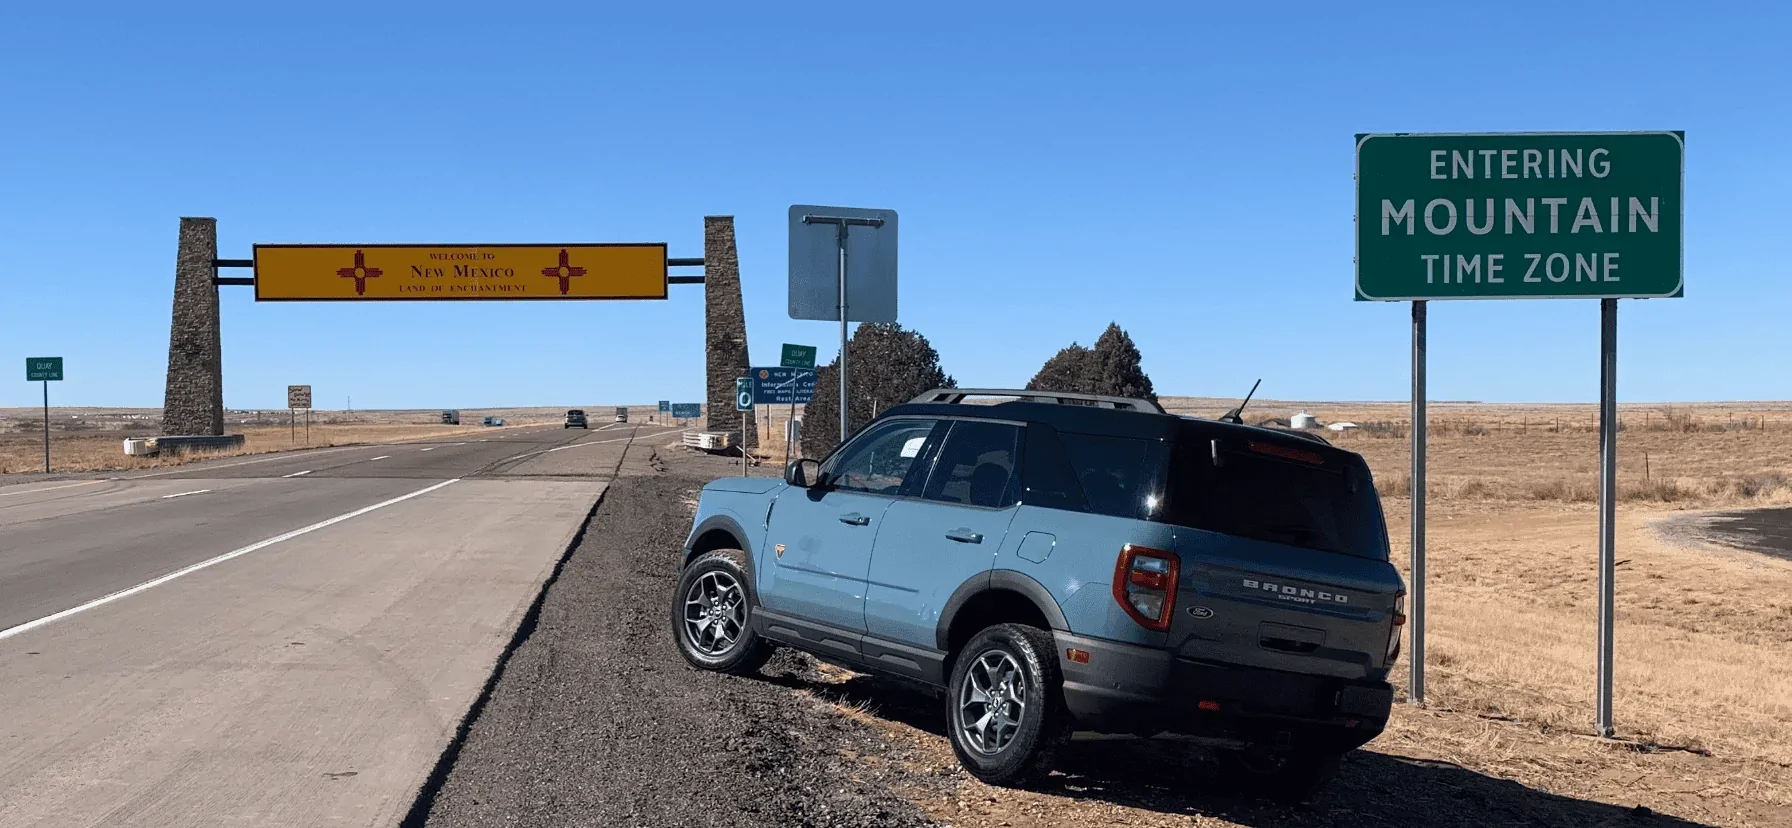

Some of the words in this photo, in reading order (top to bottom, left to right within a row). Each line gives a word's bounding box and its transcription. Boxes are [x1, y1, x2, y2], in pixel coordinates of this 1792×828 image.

[1430, 148, 1611, 180] ENTERING
[1381, 196, 1660, 235] MOUNTAIN
[429, 252, 478, 260] WELCOME
[483, 252, 495, 260] TO
[1421, 254, 1505, 284] TIME
[1523, 252, 1621, 283] ZONE
[399, 284, 426, 293] LAND
[431, 284, 444, 293] OF
[450, 283, 528, 293] ENCHANTMENT
[739, 391, 752, 407] 0
[1243, 579, 1349, 603] BRONCO
[1278, 594, 1317, 605] SPORT
